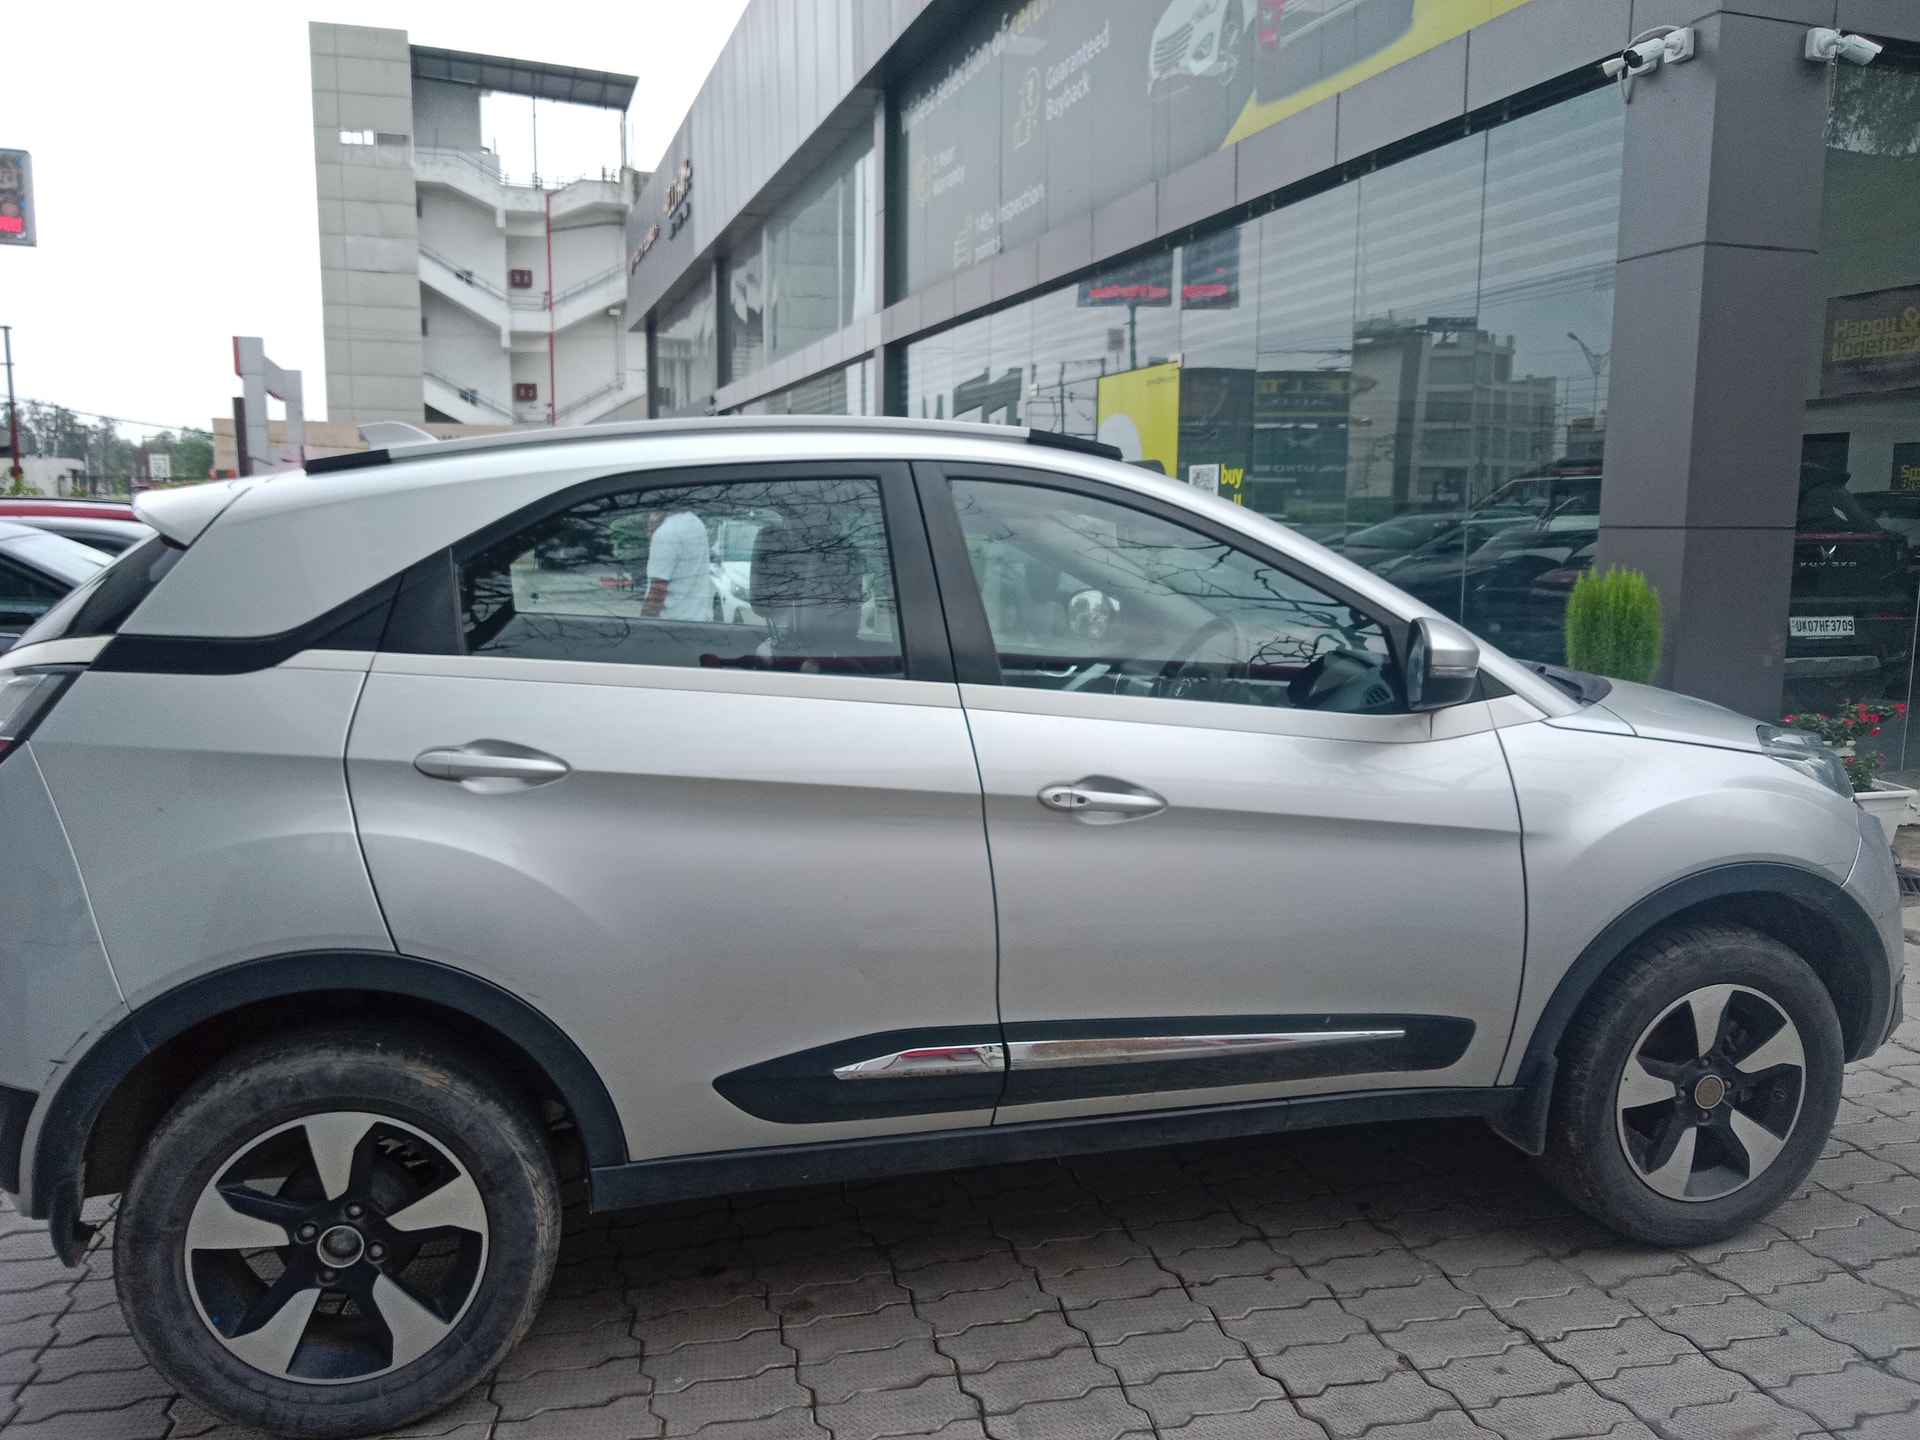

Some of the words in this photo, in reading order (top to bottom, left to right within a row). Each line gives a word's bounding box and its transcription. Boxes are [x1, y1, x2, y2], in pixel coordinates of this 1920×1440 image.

[1045, 20, 1109, 90] Guaranteed
[1045, 72, 1090, 120] Buyback
[1833, 318, 1898, 338] Happy
[1220, 463, 1244, 489] buy
[1796, 619, 1855, 633] UK07HF3709
